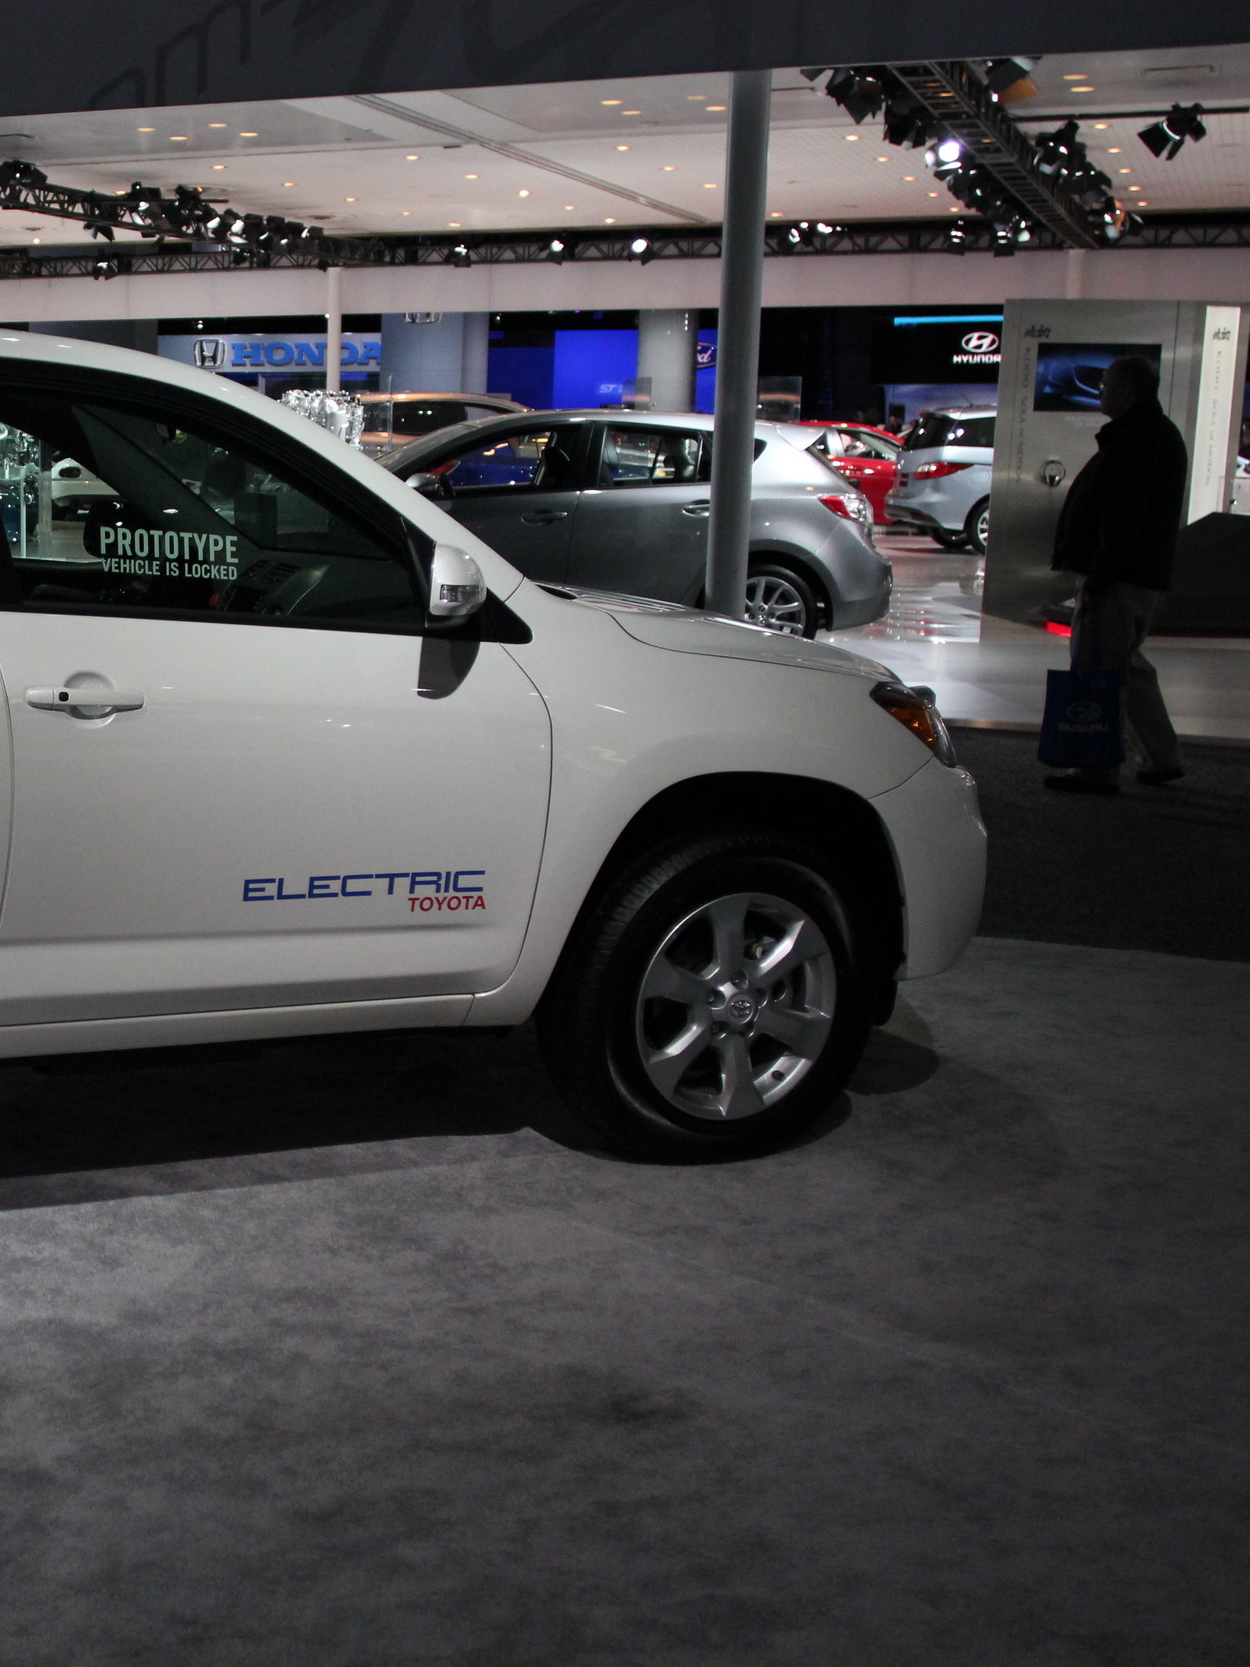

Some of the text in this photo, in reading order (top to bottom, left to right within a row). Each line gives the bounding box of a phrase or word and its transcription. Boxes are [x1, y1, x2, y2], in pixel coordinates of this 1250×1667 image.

[100, 526, 239, 564] PROTOTYPE
[101, 556, 238, 581] VEHICLE IS LOCKED
[243, 870, 486, 902] ELECTRIC
[408, 895, 486, 912] TOYOTA
